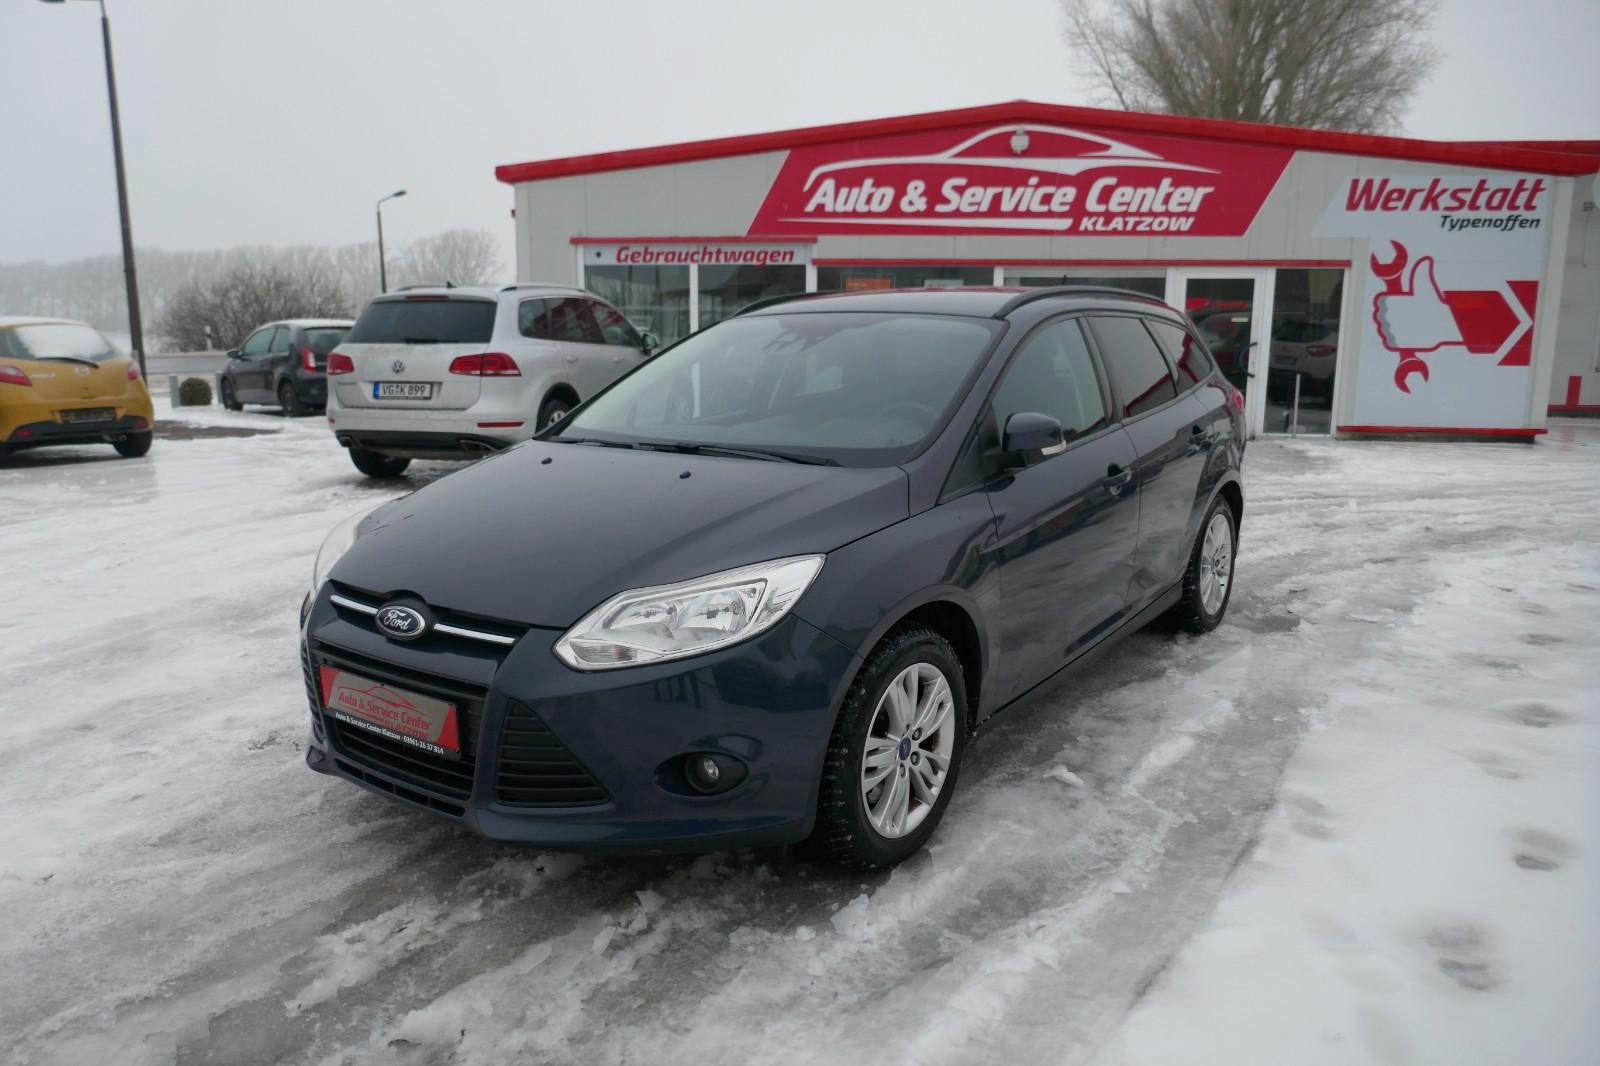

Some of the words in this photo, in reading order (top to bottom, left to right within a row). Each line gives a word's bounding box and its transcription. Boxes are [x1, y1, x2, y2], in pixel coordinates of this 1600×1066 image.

[805, 178, 894, 213] Auto
[900, 180, 928, 212] &
[935, 177, 1077, 213] Service
[1085, 178, 1215, 214] Center
[1345, 178, 1547, 212] Werkstatt
[1079, 216, 1195, 232] KLATZOW
[1439, 215, 1541, 232] Typenoffen
[615, 245, 795, 268] Gebrauchtwagen
[408, 385, 426, 395] 899
[383, 609, 411, 631] Ford
[338, 691, 358, 707] Auto
[367, 701, 399, 720] Service
[401, 712, 432, 730] Center
[335, 711, 347, 721] Auto
[350, 716, 367, 729] Service
[367, 723, 382, 734] Center
